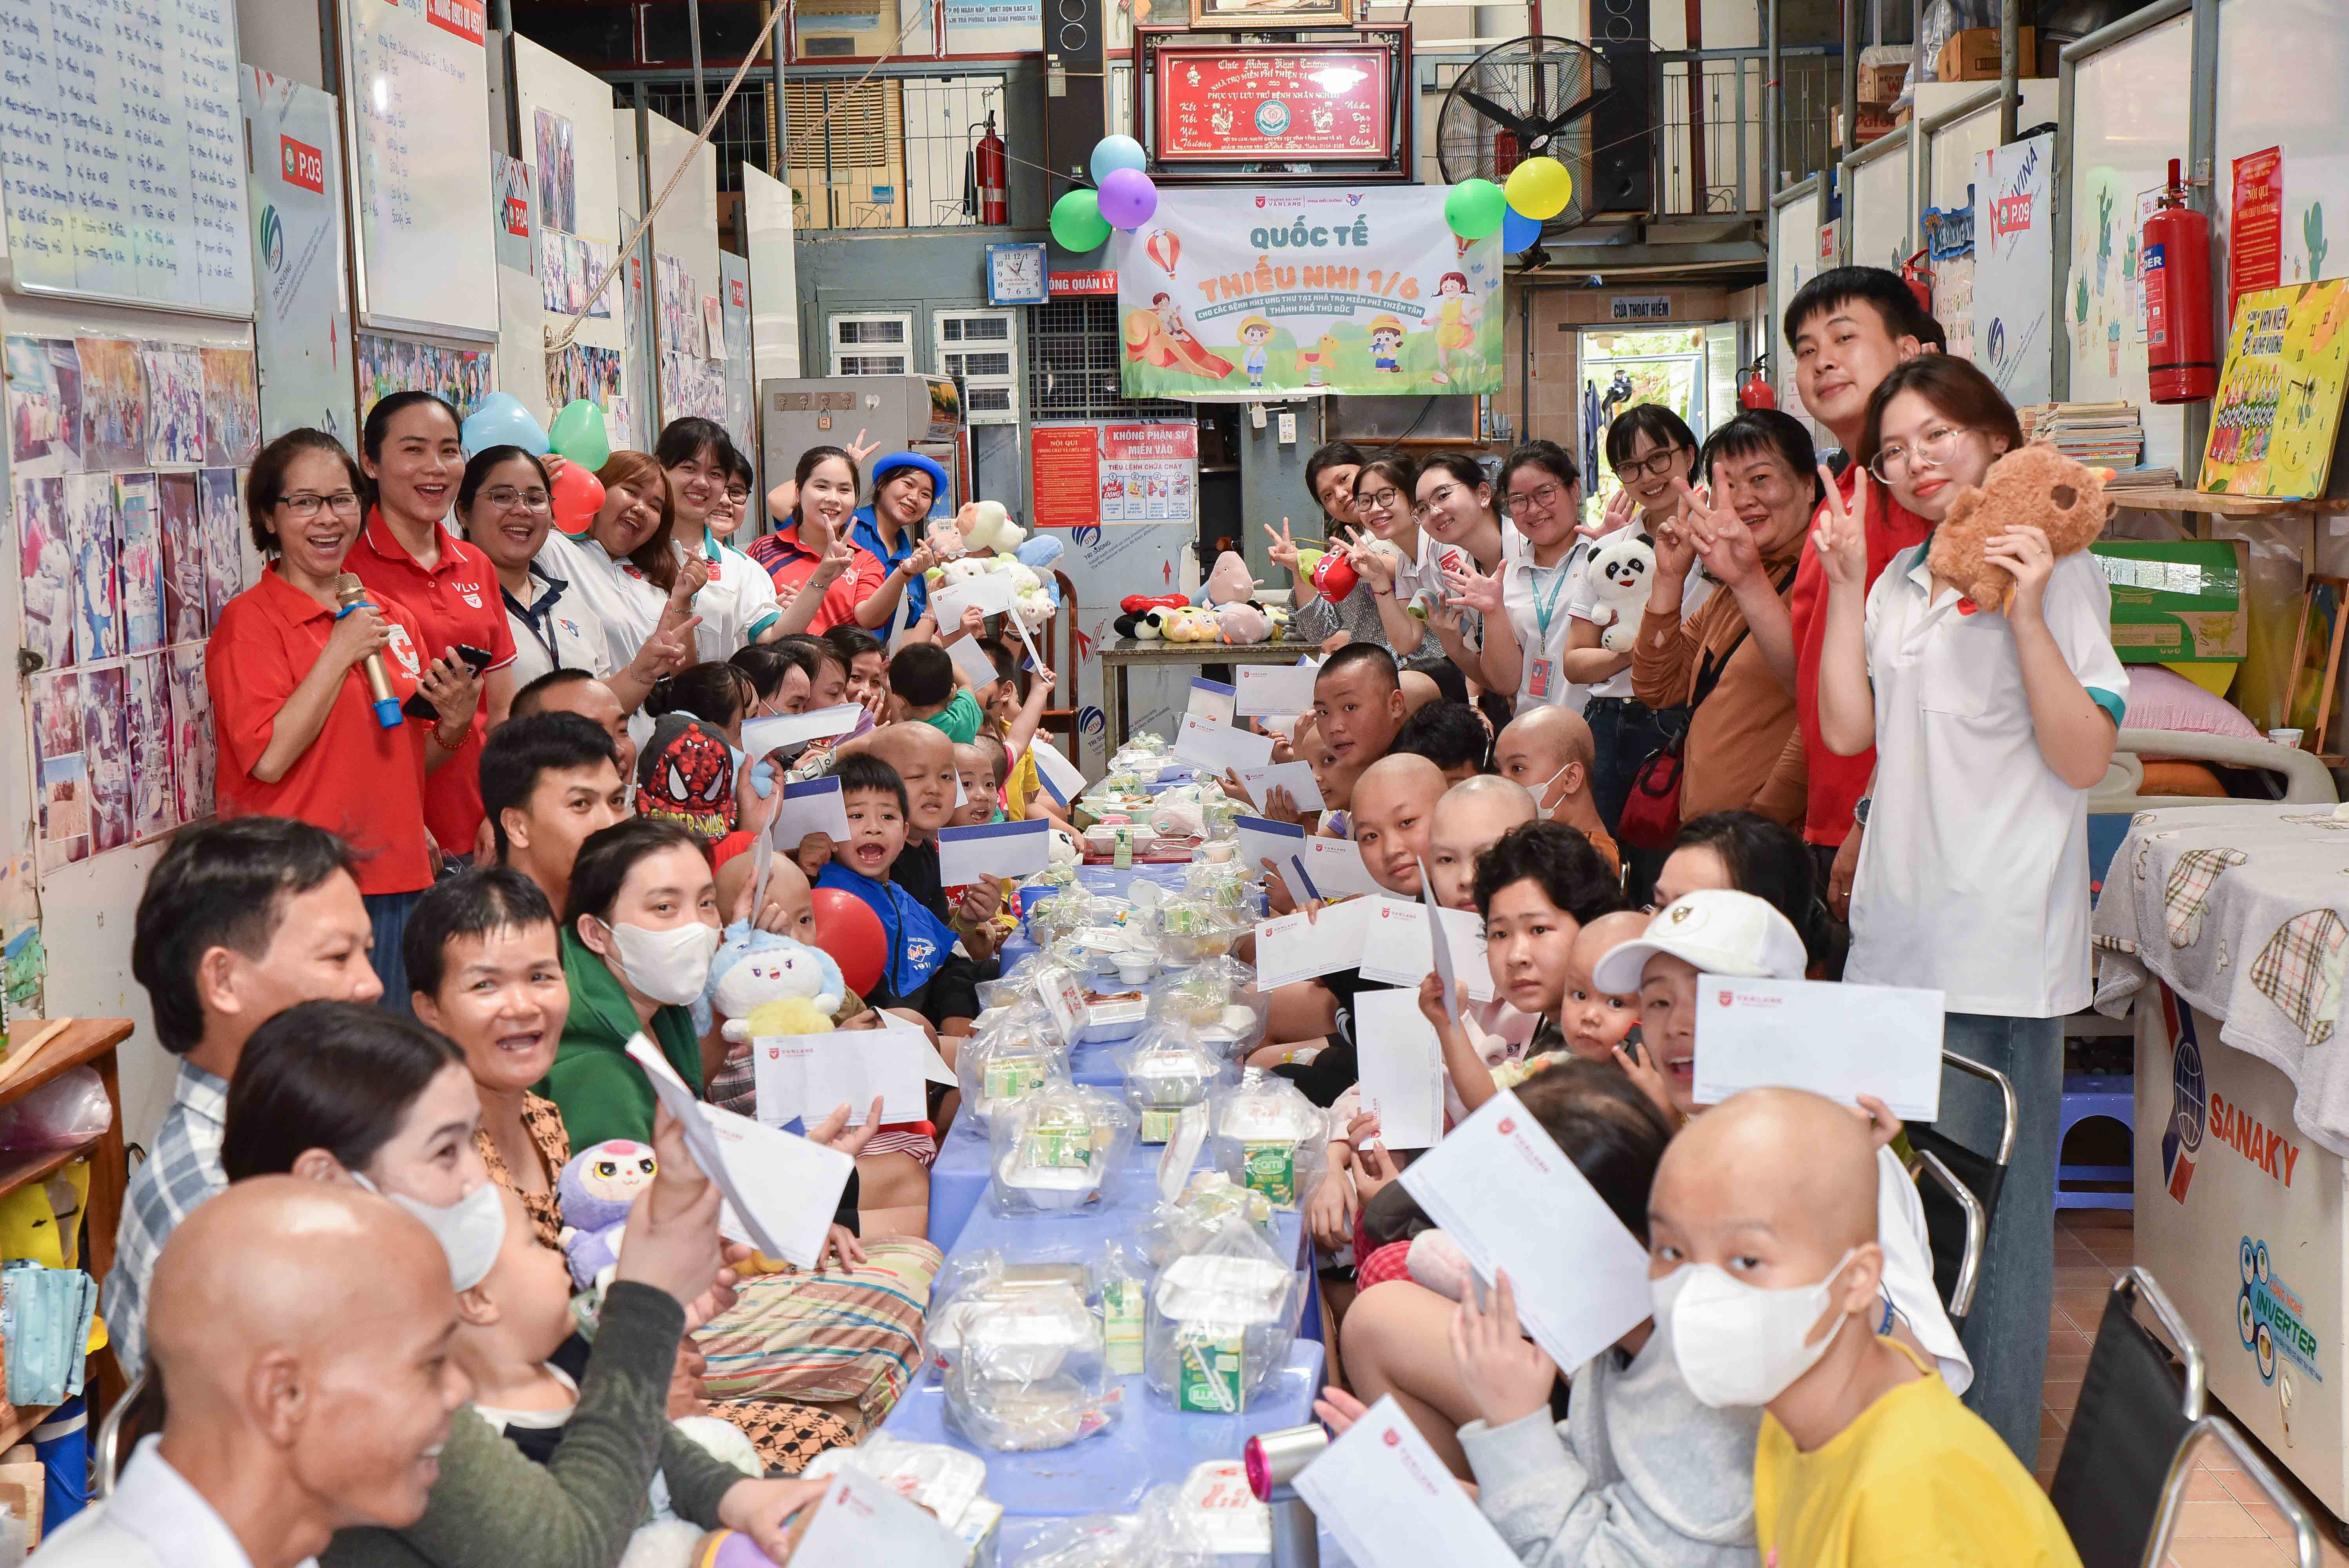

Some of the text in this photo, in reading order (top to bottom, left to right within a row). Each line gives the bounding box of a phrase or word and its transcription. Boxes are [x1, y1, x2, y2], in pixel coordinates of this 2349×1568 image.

[451, 1, 463, 28] 0903
[463, 6, 470, 31] 00
[470, 10, 482, 36] 4531
[298, 151, 322, 184] P.03
[2248, 184, 2268, 202] NỘI QUI
[515, 207, 527, 229] P.04
[2011, 202, 2030, 223] P.09
[1250, 213, 1368, 249] QUỐC TẾ
[1049, 275, 1114, 291] ÒNG QUẢN LÝ
[1198, 254, 1419, 303] THIẾU NHI 1/6
[1198, 310, 1212, 319] CHO
[1265, 296, 1280, 305] UNG
[1614, 296, 1669, 318] CỬA THOÁT HIỂM
[2322, 311, 2330, 325] 12
[2309, 324, 2316, 337] 11
[2333, 322, 2338, 335] 1
[2296, 349, 2304, 362] 10
[2334, 346, 2340, 360] 2
[2287, 383, 2293, 396] 9
[2330, 381, 2336, 395] 3
[2282, 416, 2287, 431] 8
[2318, 416, 2324, 430] 4
[1113, 430, 1145, 440] KHÔNG
[2284, 441, 2289, 454] 7
[2305, 441, 2311, 455] 5
[2292, 451, 2297, 465] 6
[1084, 534, 1097, 545] DTH
[452, 582, 480, 593] VLU
[1088, 721, 1100, 732] DTH
[2209, 1092, 2300, 1189] SANAKY
[2256, 1288, 2317, 1362] INVERTER
